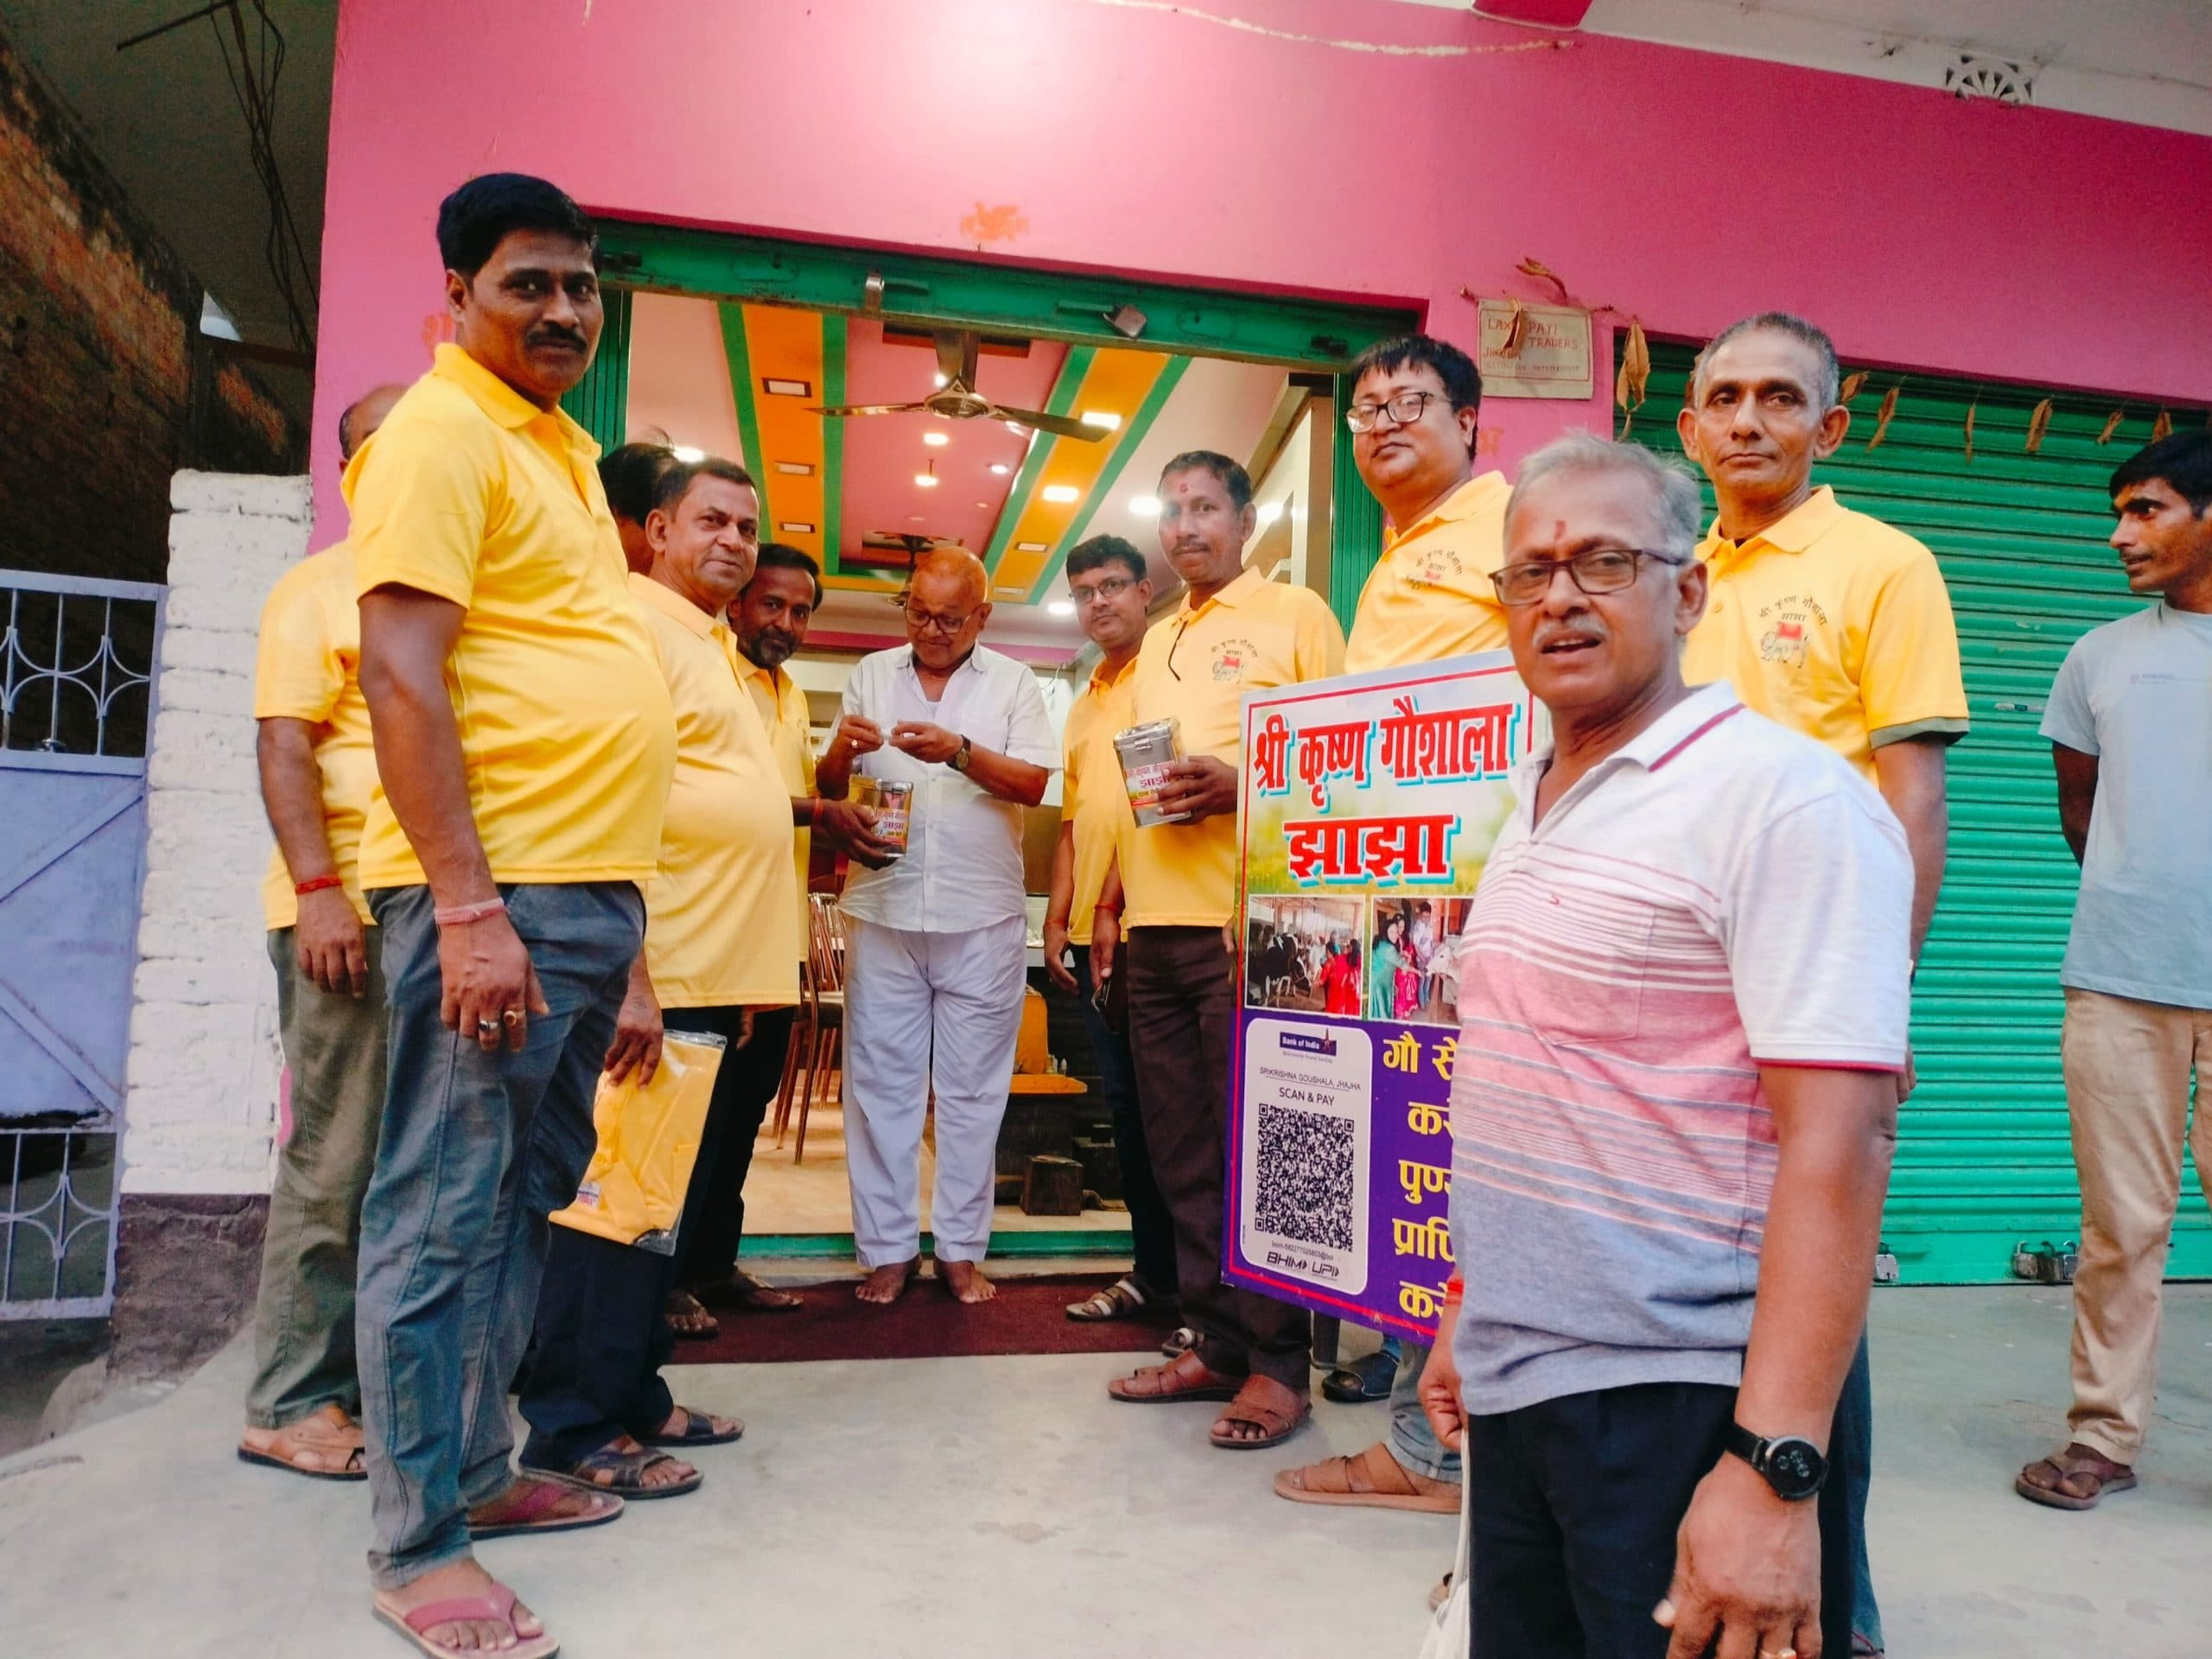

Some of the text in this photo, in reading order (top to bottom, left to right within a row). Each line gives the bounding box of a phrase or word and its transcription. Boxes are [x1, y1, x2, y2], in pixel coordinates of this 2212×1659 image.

[1528, 337, 1578, 350] TRADERS
[1254, 696, 1514, 807] श्री कृष्ण गौशाला
[1284, 815, 1454, 880] झाझा
[1282, 1036, 1297, 1046] Bank
[1306, 1039, 1319, 1050] India
[1382, 1030, 1458, 1081] गौ से
[1260, 1066, 1361, 1090] SRIKRISHNA GOUSHALA, JHAJHA
[1279, 1087, 1335, 1106] SCAN & PAY
[1267, 1251, 1302, 1269] BHIM
[1312, 1262, 1335, 1276] UPI
